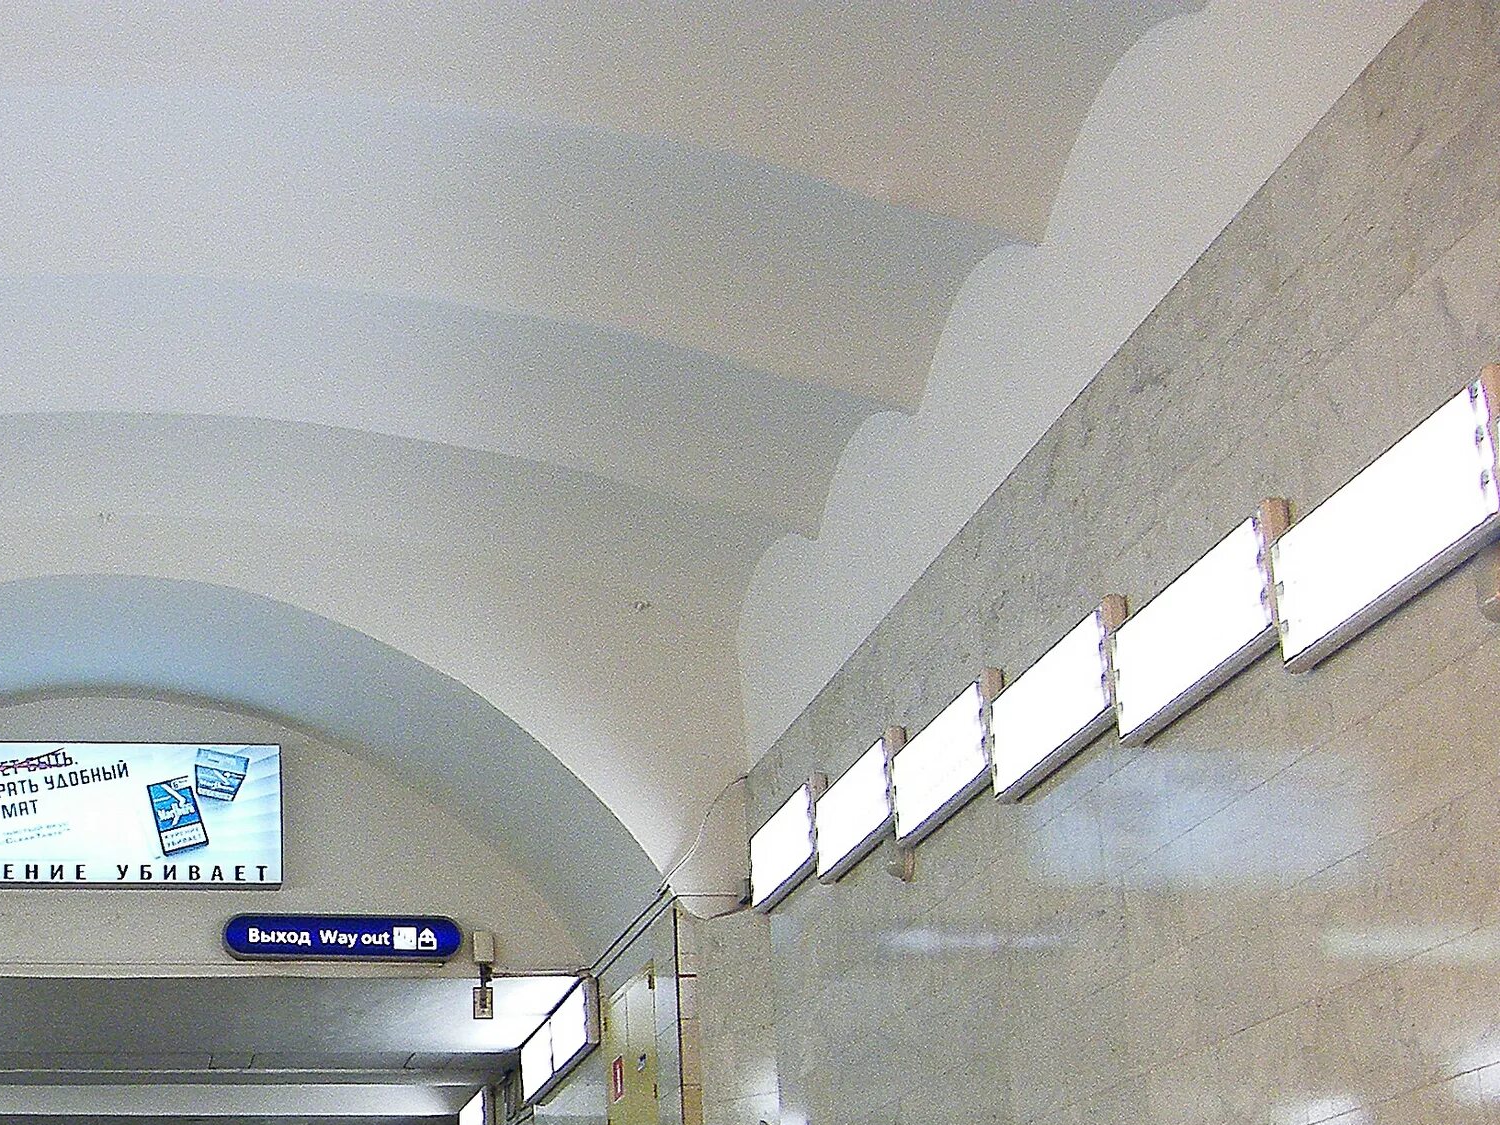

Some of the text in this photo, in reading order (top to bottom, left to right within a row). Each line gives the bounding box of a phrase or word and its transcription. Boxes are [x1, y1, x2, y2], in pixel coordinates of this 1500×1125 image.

[44, 759, 130, 790] УДОБНЫЙ
[116, 863, 270, 882] УБИВАЕТ
[248, 926, 390, 948] Выход Way out
